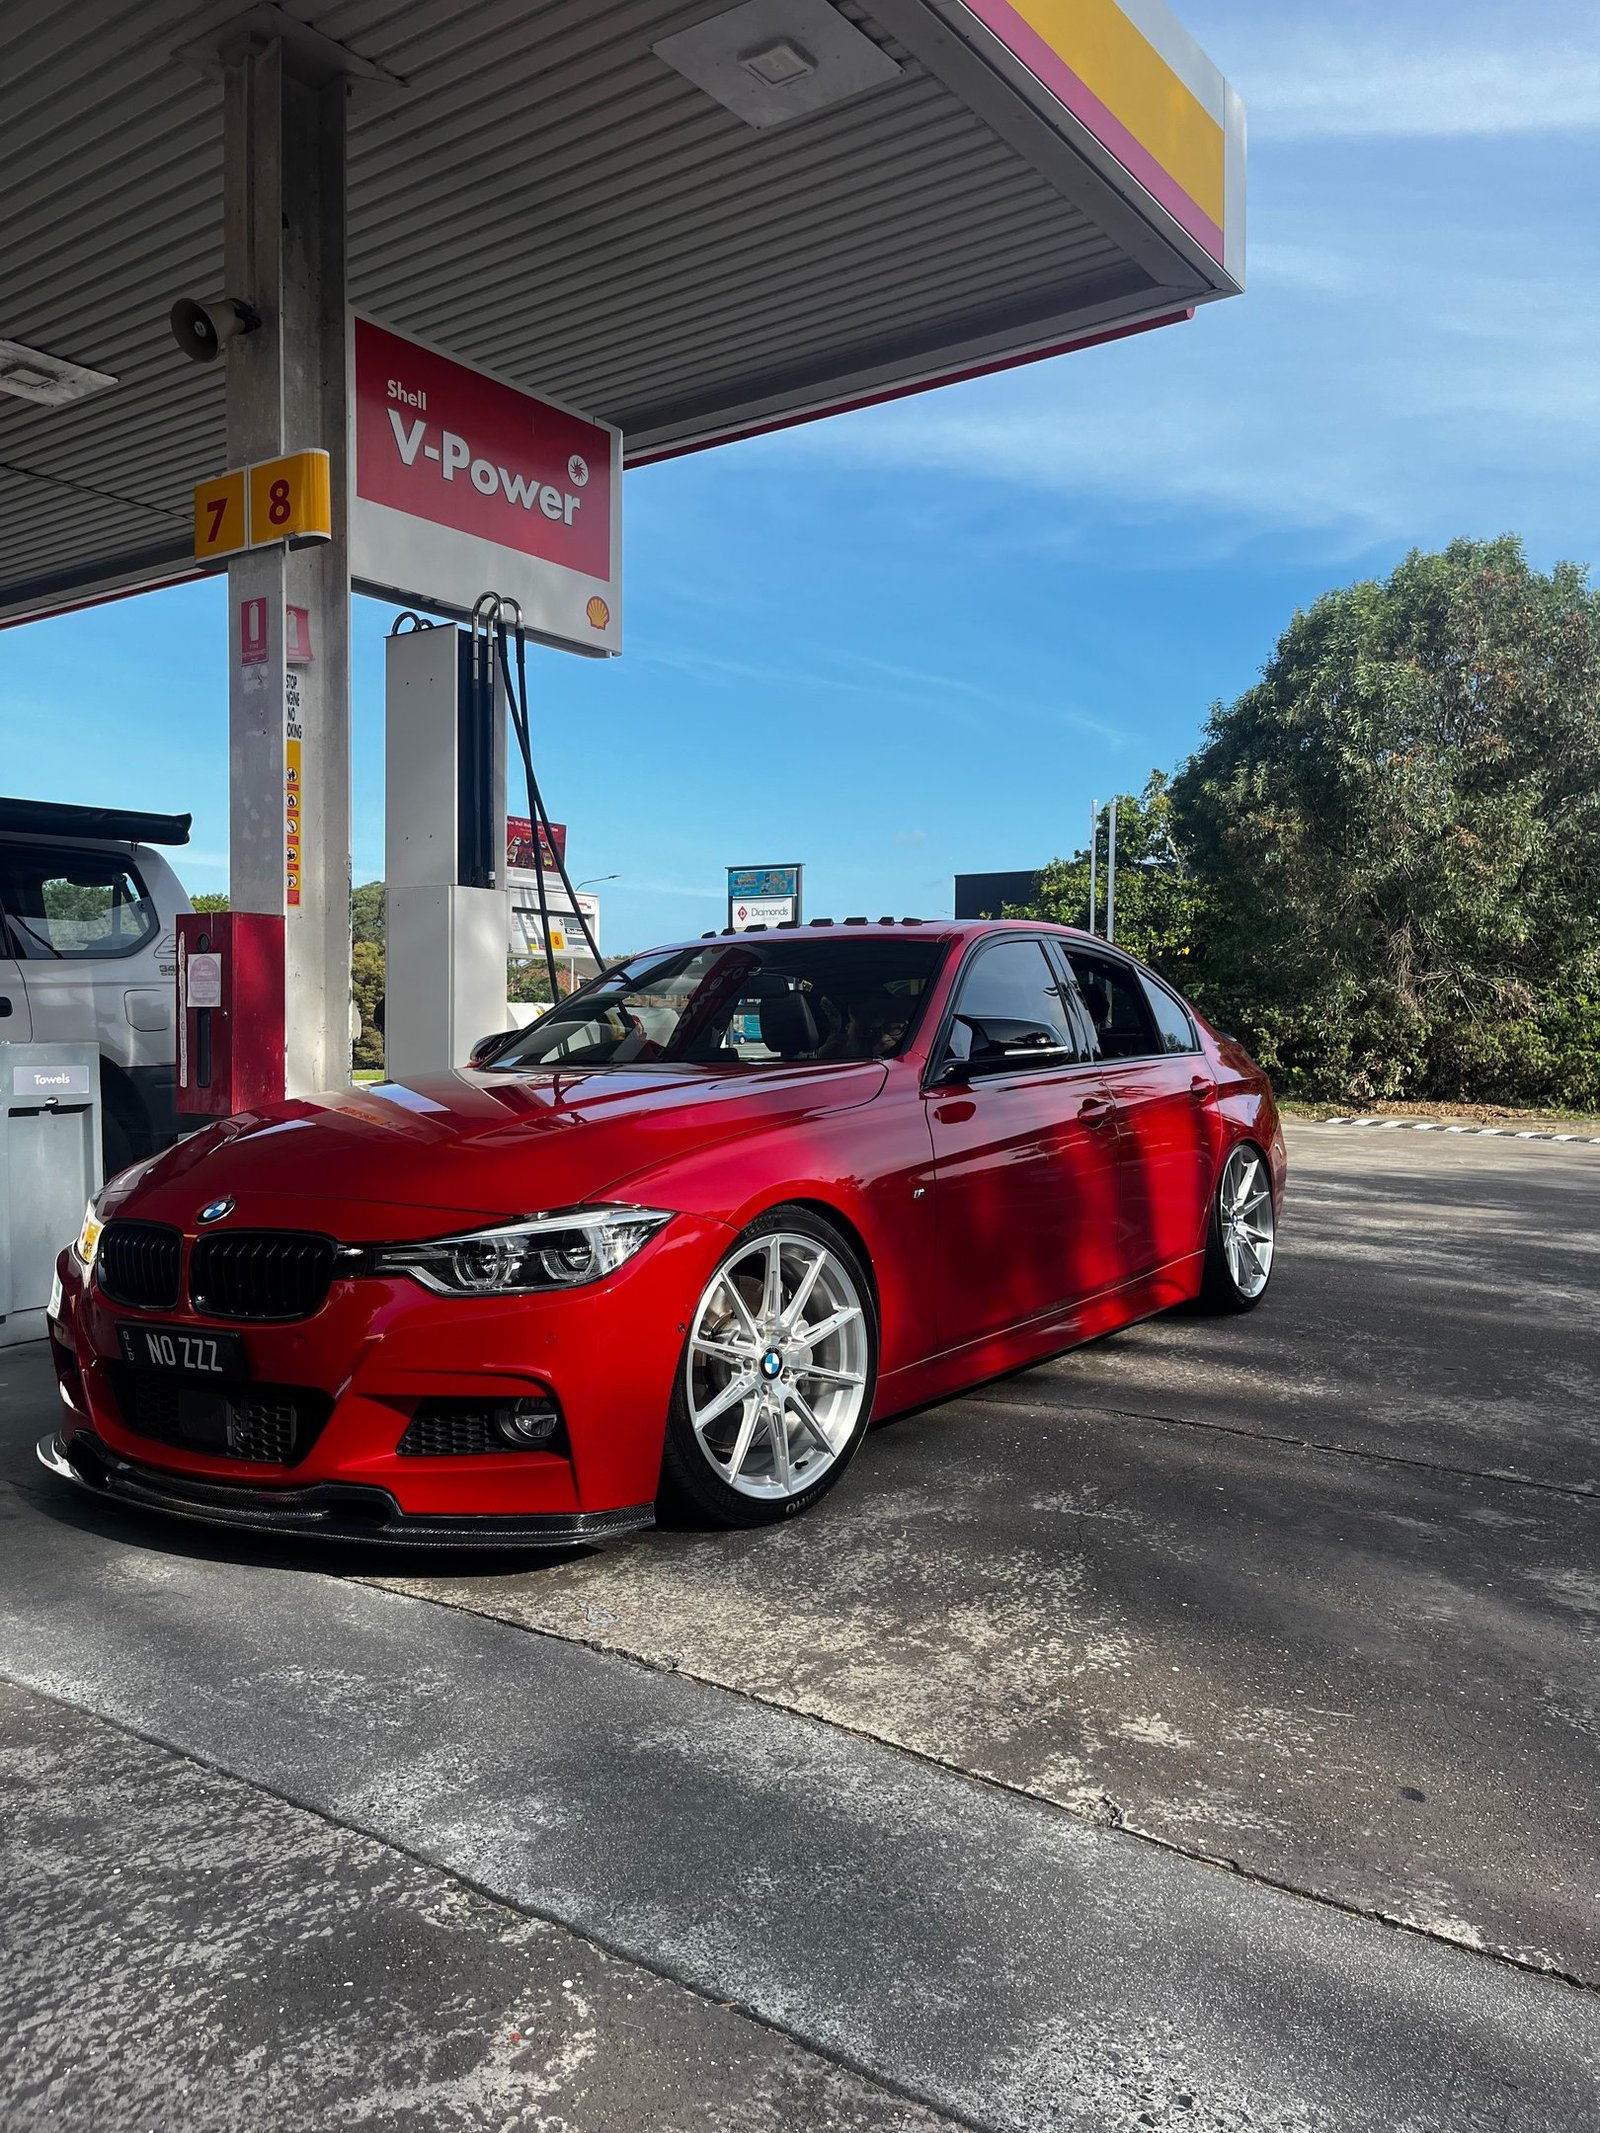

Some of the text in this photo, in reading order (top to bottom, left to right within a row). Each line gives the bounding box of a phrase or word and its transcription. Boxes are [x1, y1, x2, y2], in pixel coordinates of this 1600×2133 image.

[387, 379, 427, 411] Shell
[387, 408, 581, 526] V-Power
[269, 479, 291, 525] 8
[206, 497, 228, 542] 7
[286, 674, 297, 689] STOP
[286, 691, 300, 706] NGINE
[287, 707, 296, 721] NO
[751, 907, 788, 917] Diamonds
[554, 936, 559, 946] 8
[33, 1073, 70, 1085] Towels
[145, 1333, 223, 1372] NO ZZZ
